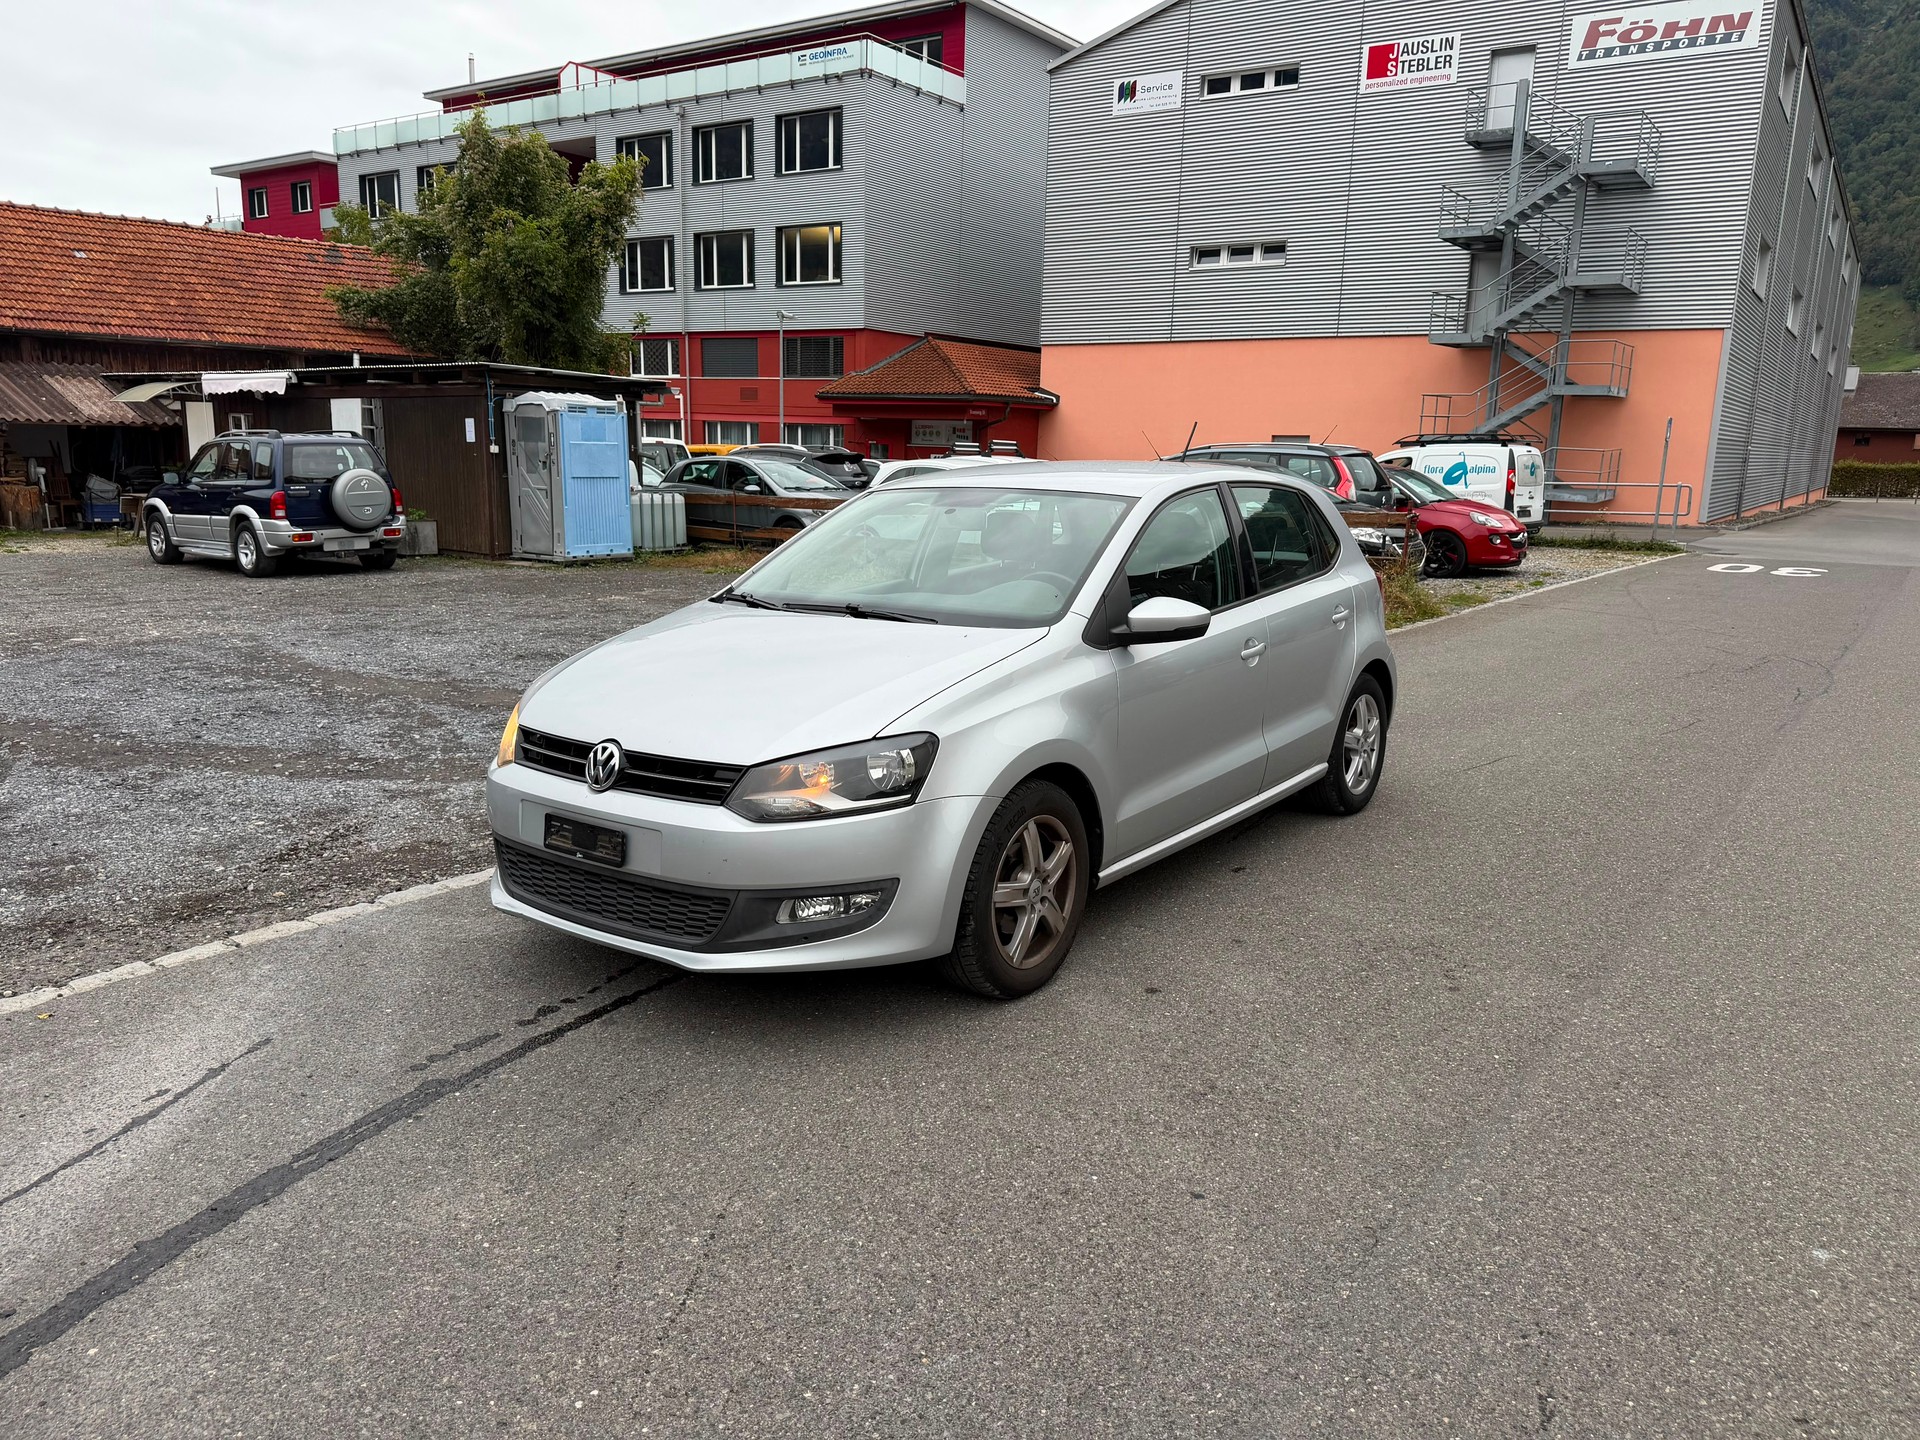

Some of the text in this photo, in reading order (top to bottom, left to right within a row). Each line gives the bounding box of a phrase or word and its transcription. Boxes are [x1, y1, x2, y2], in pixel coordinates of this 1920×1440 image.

[1581, 11, 1754, 49] FÖHN
[809, 47, 848, 61] GEOINFRA
[1389, 36, 1455, 59] JAUSLIN
[1580, 31, 1742, 60] TRANSPORTE
[1386, 54, 1453, 76] STEBLER
[1364, 73, 1452, 91] personalized engineering
[1423, 464, 1497, 475] flora alpina
